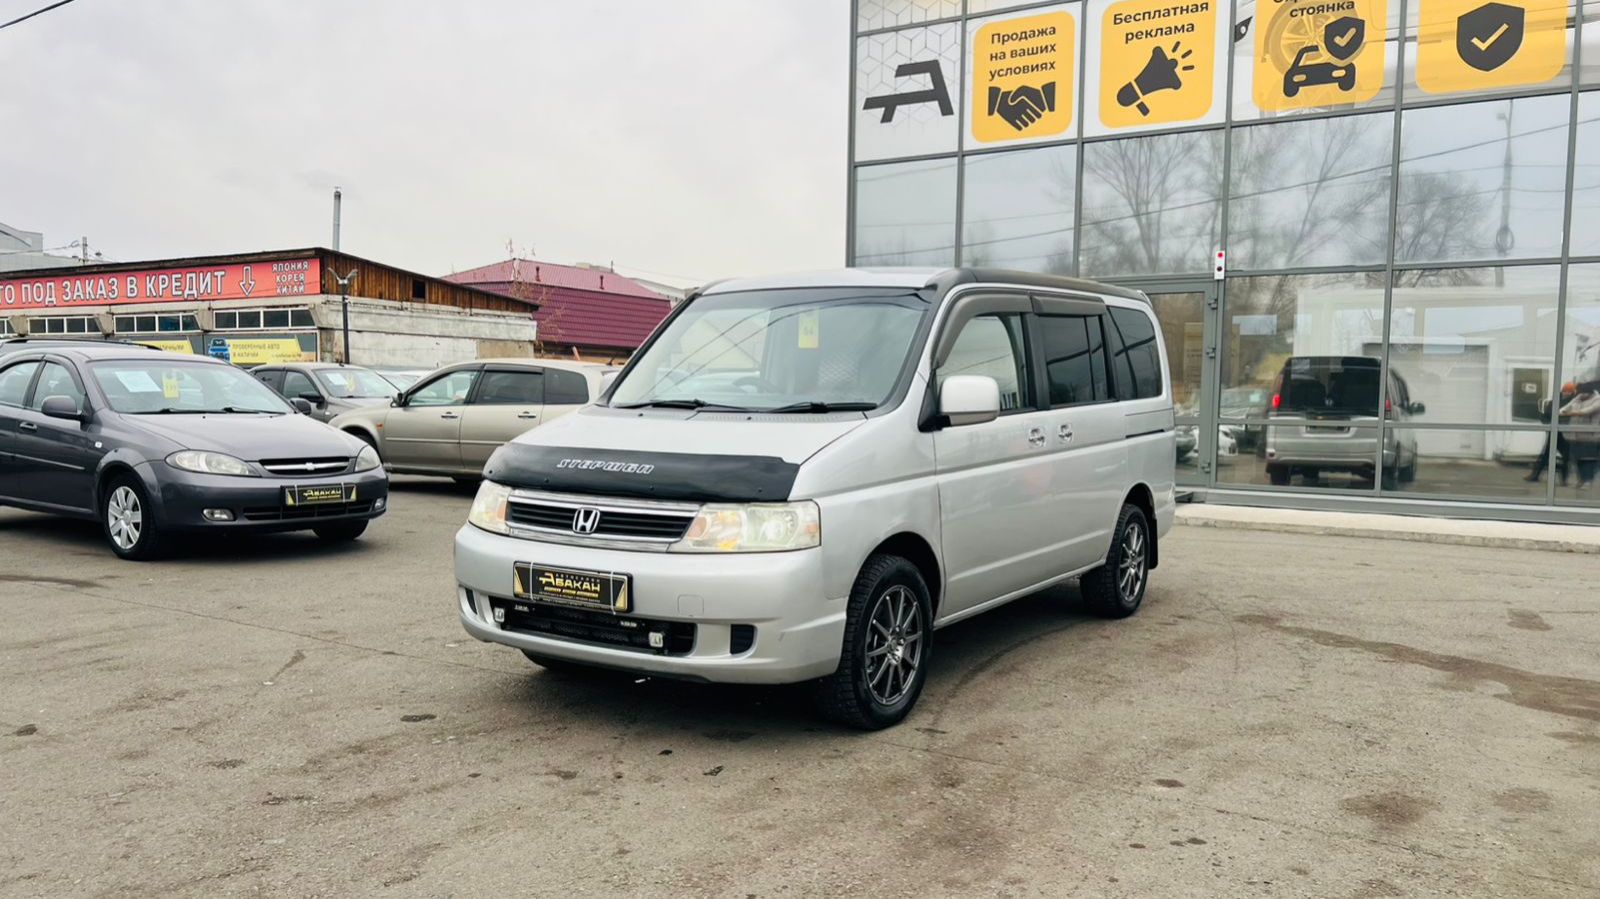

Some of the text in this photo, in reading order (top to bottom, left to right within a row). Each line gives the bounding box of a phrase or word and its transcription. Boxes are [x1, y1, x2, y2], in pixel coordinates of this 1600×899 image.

[1113, 2, 1209, 25] Бесплатная
[1289, 1, 1355, 18] стоянка
[991, 26, 1056, 45] Продажа
[1125, 23, 1195, 44] реклама
[990, 43, 1056, 61] на ваших
[989, 61, 1056, 81] условиях
[272, 261, 309, 272] ЯПОНИЯ
[276, 273, 305, 283] КОРЕЯ
[21, 281, 57, 305] ПОД
[62, 277, 119, 301] ЗАКАЗ
[127, 276, 138, 298] В
[146, 271, 226, 299] КРЕДИТ
[276, 284, 305, 295] КИТАЙ
